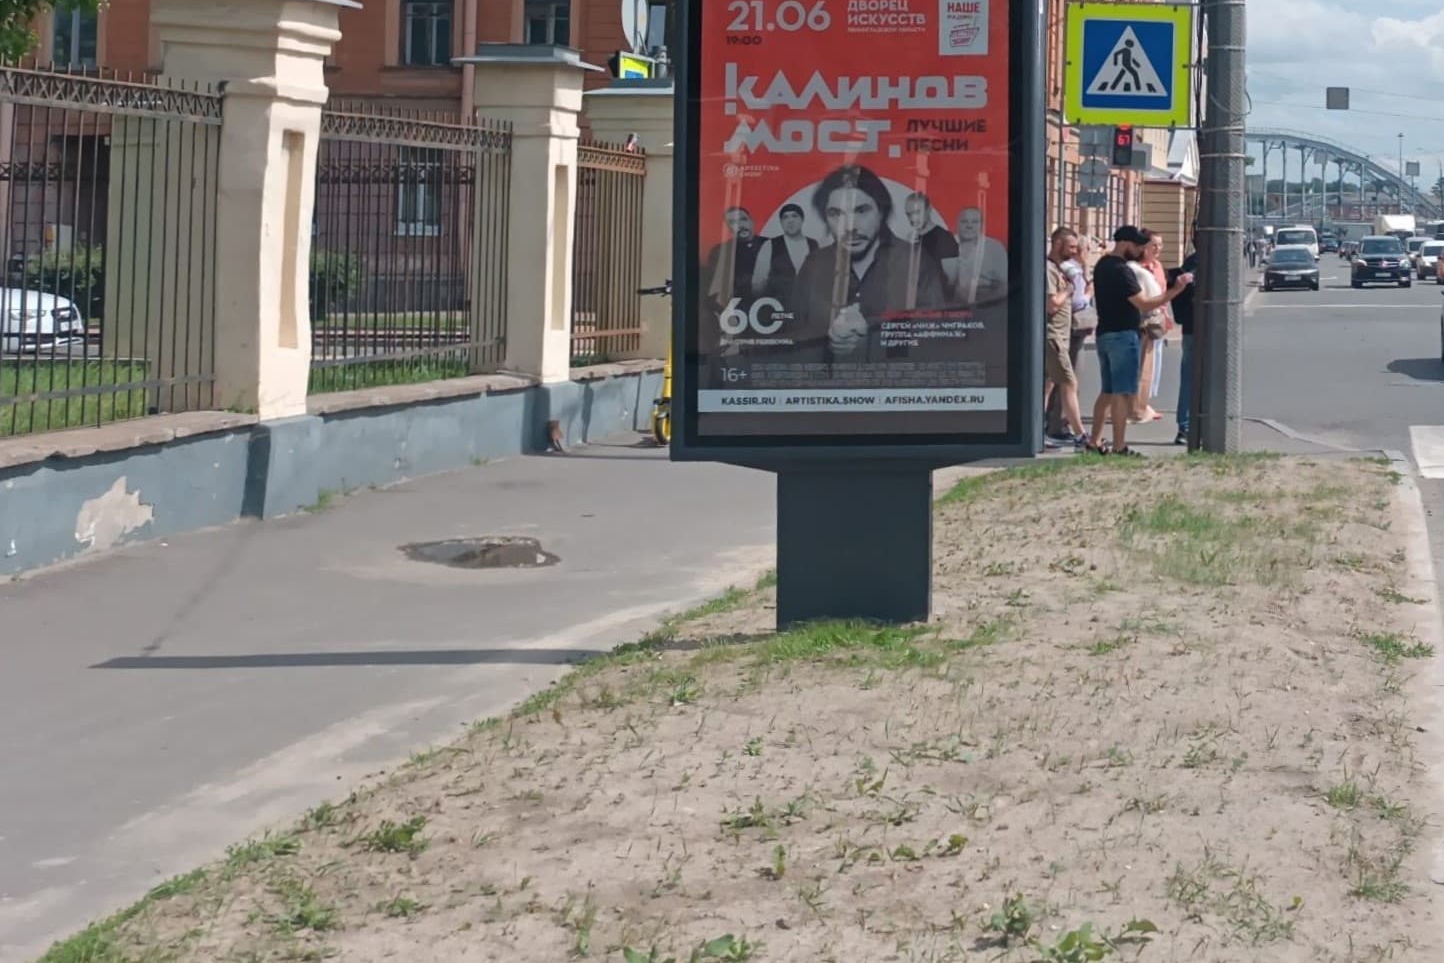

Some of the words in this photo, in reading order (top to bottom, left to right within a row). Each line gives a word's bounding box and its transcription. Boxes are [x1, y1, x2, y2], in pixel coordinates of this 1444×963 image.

[847, 0, 909, 12] ДВОРЕЦ
[947, 1, 981, 14] НАШЕ
[726, 0, 831, 31] 21.06
[847, 13, 926, 25] ИСКУССТВ
[906, 119, 987, 134] ЛУЧШИЕ
[906, 138, 969, 153] ПЕСНИ
[721, 367, 747, 382] 16+
[721, 396, 776, 406] KASSIR.RU
[785, 395, 875, 405] ARTISTIKA.SHOW
[885, 394, 985, 404] AFISHA.YANDEX.RU
